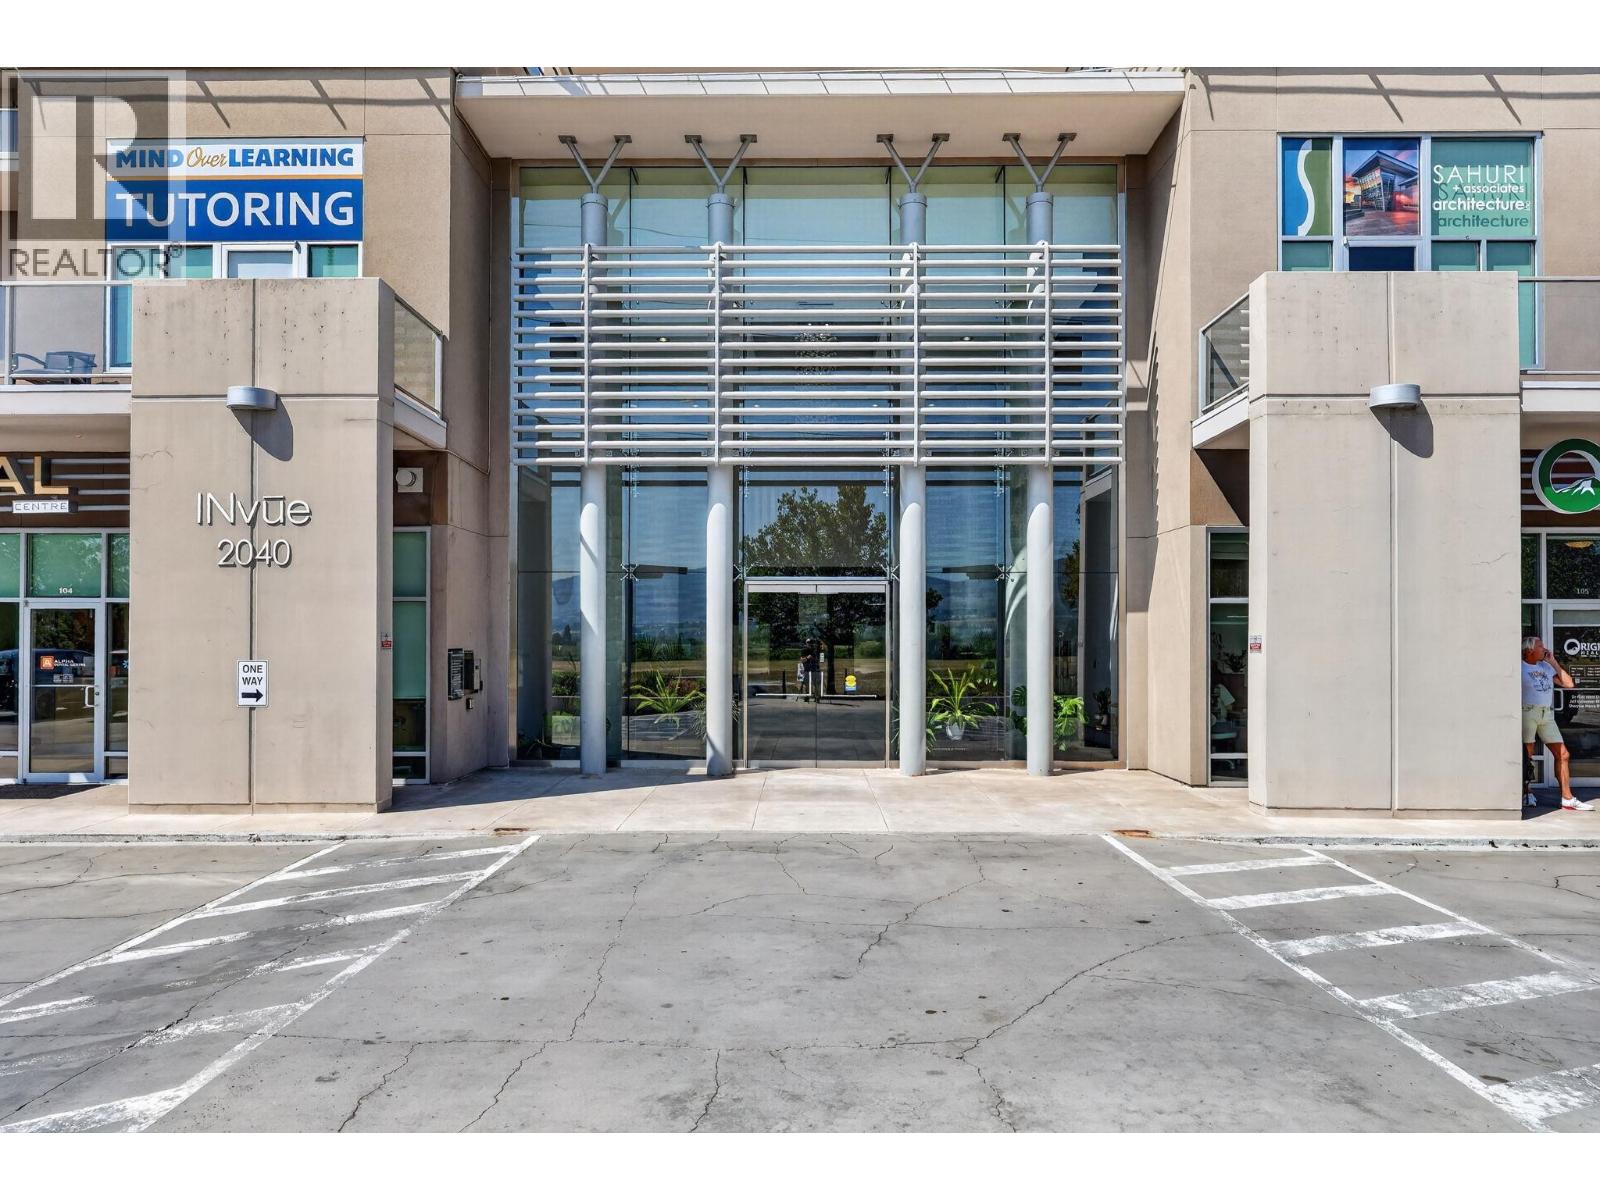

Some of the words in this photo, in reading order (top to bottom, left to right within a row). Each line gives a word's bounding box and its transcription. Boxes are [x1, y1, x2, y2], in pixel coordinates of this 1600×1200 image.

[116, 150, 184, 168] MIND
[187, 147, 227, 168] Over
[229, 148, 353, 167] LEARNING
[1433, 165, 1524, 183] SAHURI
[1464, 183, 1525, 193] associates
[116, 192, 353, 227] TUTORING
[1432, 198, 1525, 211] architecture
[15, 503, 67, 511] CENTRE
[218, 539, 291, 566] 2040
[242, 664, 264, 674] ONE
[241, 676, 264, 686] WAY
